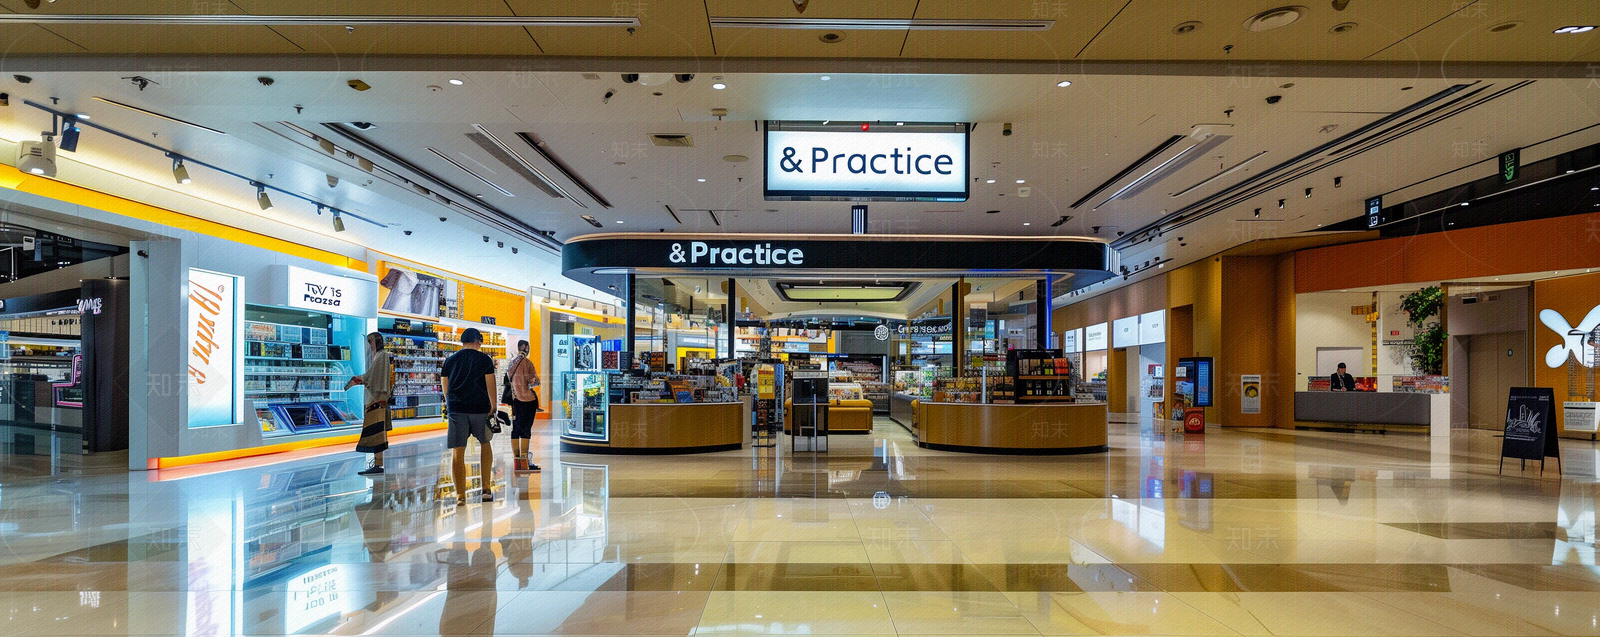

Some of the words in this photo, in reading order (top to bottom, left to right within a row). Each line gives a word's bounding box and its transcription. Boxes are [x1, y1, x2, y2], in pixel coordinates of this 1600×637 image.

[780, 146, 803, 174] &
[811, 147, 954, 175] Practice
[669, 242, 686, 263] &
[690, 241, 804, 264] Practice
